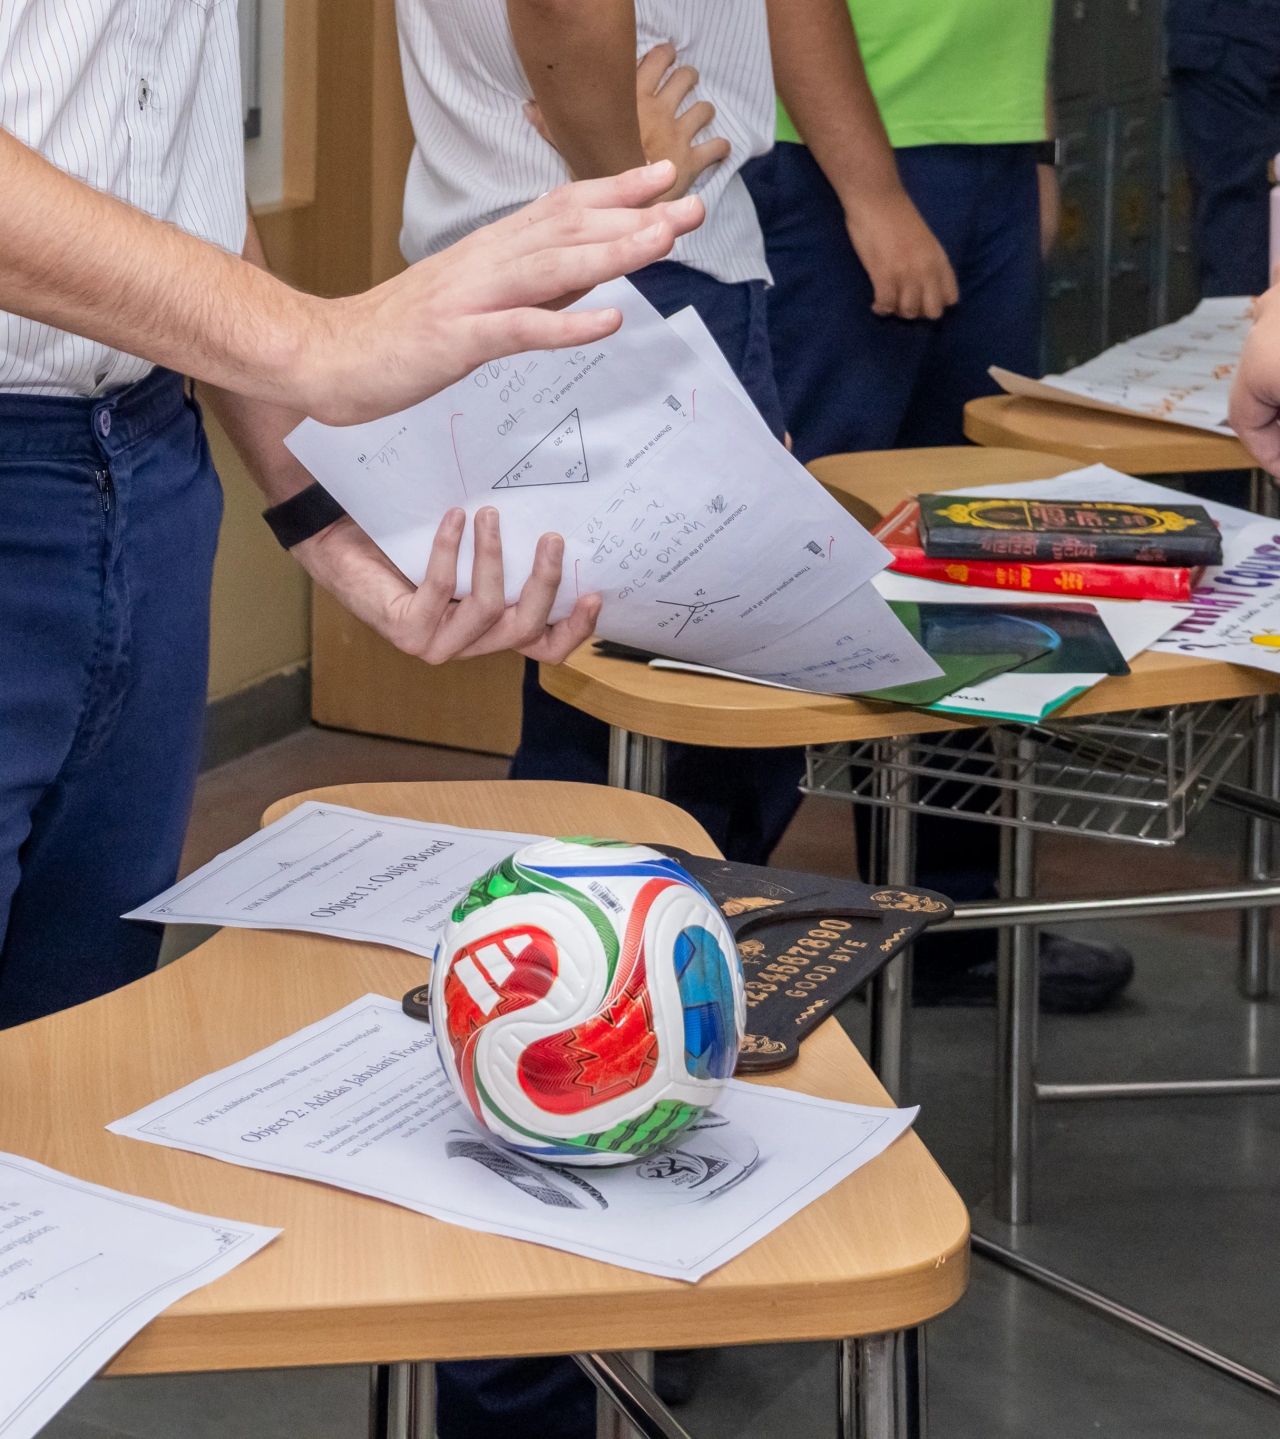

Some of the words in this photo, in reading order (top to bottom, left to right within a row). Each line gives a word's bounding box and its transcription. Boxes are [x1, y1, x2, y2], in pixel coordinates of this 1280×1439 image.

[590, 352, 606, 367] Work
[583, 364, 593, 375] out
[574, 372, 584, 384] the
[560, 380, 576, 396] value
[656, 424, 672, 441] Shown
[554, 439, 563, 447] 20
[623, 448, 646, 469] triangle.
[565, 470, 574, 479] 20
[722, 504, 748, 527] Calculate
[713, 523, 725, 534] the
[703, 531, 716, 545] size
[689, 547, 700, 559] the
[672, 555, 691, 573] largest
[793, 565, 812, 581] Three
[776, 574, 795, 592] angles
[694, 588, 706, 597] 2x
[764, 588, 778, 601] meet
[403, 839, 455, 868] Board
[369, 859, 419, 883] Ouija
[356, 882, 383, 892] 1:
[310, 890, 369, 918] Object
[785, 964, 837, 998] GOOD
[827, 939, 868, 963] BYE
[193, 1111, 219, 1127] TOK
[217, 1089, 258, 1116] Exhibition
[286, 1061, 310, 1078] What
[308, 1051, 335, 1070] counts
[340, 1023, 383, 1050] knowledge?
[240, 1116, 294, 1144] Object
[293, 1107, 310, 1120] 2:
[304, 1082, 352, 1111] Adidas
[348, 1054, 400, 1087] Jabulani
[304, 1137, 325, 1150] The
[322, 1122, 352, 1140] Adidas
[347, 1106, 381, 1125] Jabulani
[379, 1093, 404, 1108] shows
[400, 1083, 418, 1094] that
[321, 1133, 359, 1155] becomes
[356, 1122, 379, 1136] more
[376, 1098, 419, 1125] convincing
[346, 1147, 362, 1158] can
[412, 1106, 428, 1119] and
[1, 1215, 32, 1230] such
